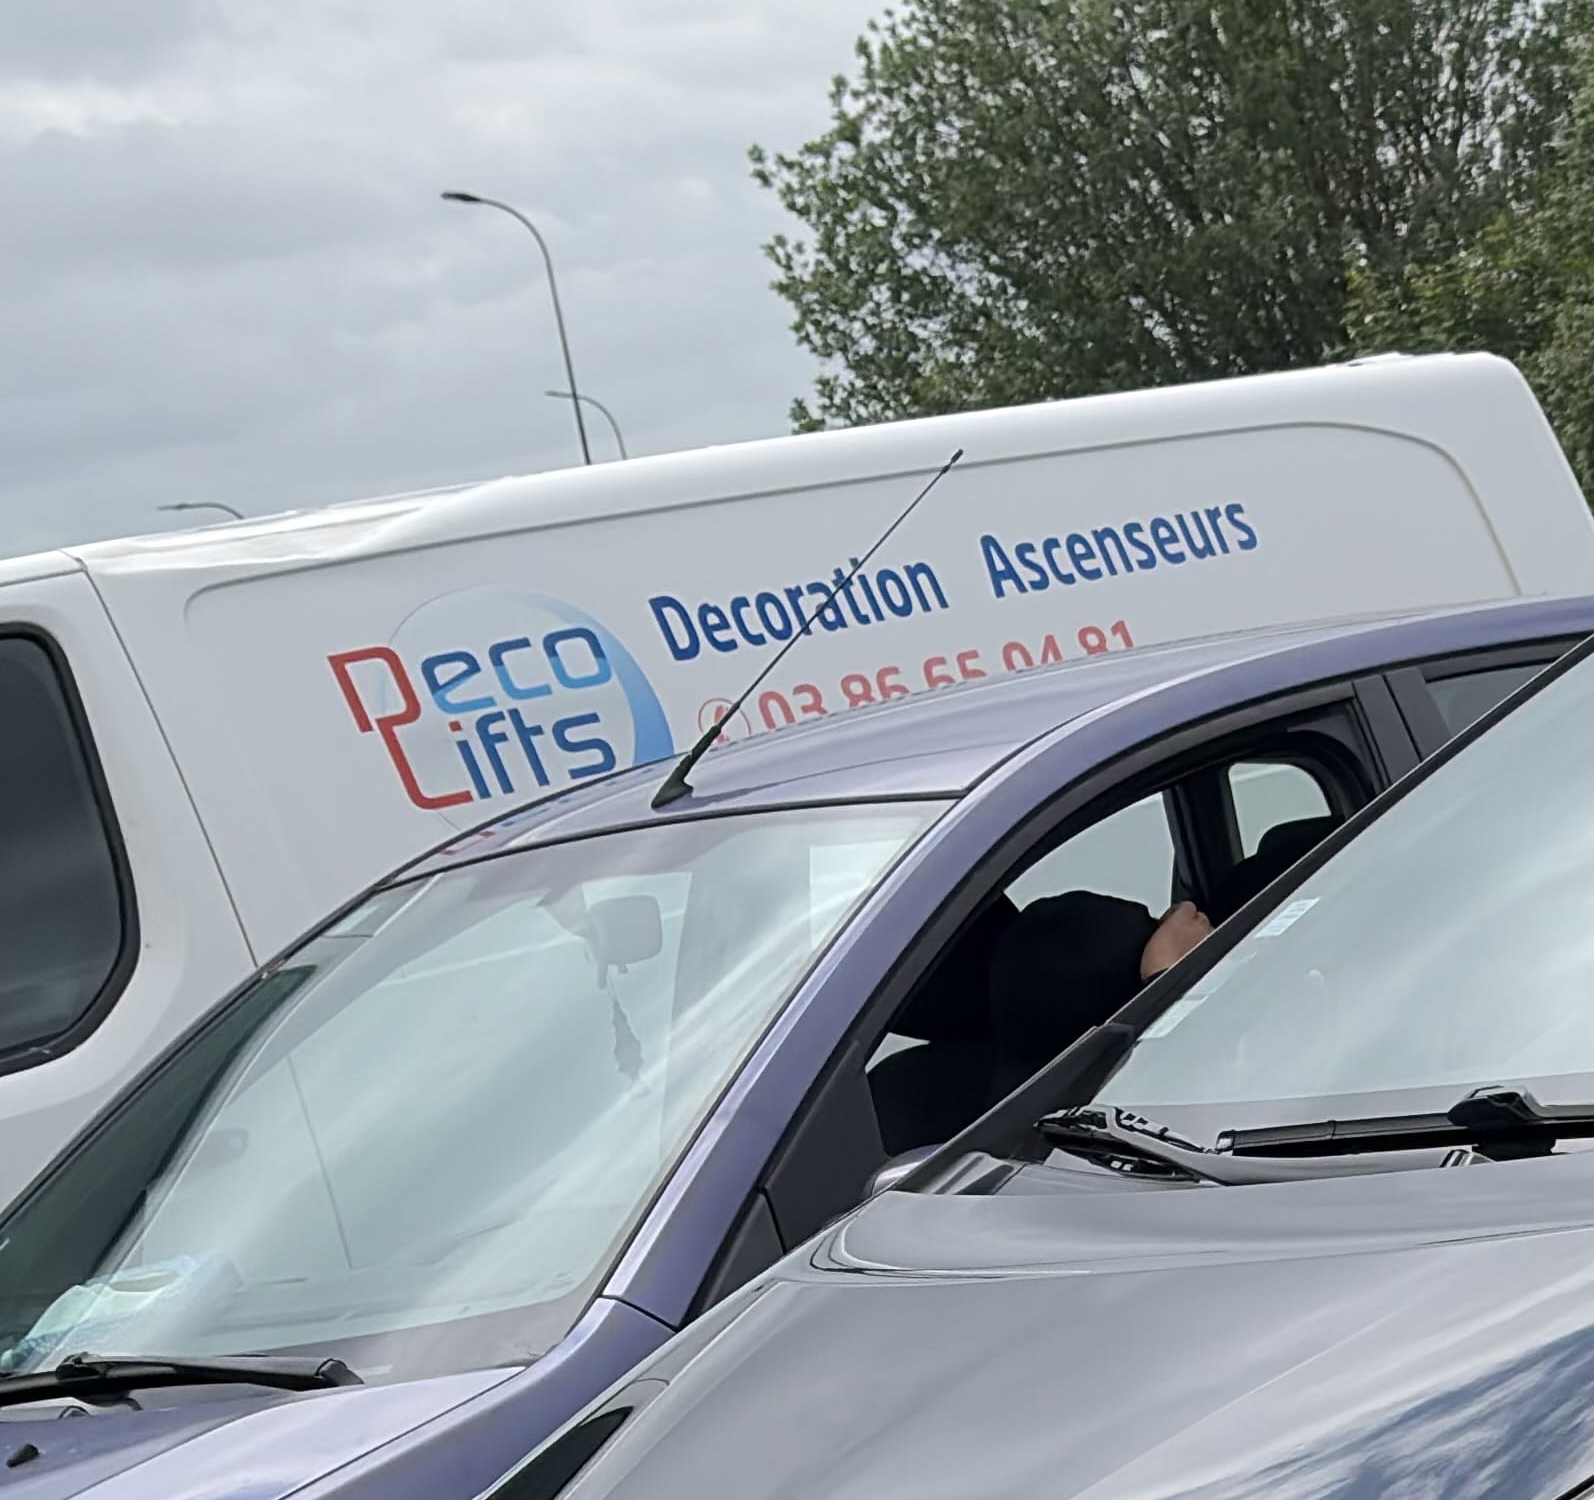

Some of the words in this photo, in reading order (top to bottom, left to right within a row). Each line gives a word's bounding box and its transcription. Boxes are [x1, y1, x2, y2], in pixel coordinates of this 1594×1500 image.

[649, 558, 949, 661] Decoration
[980, 503, 1257, 599] Ascenseurs
[326, 627, 612, 733] Deco
[376, 707, 616, 810] Lifts
